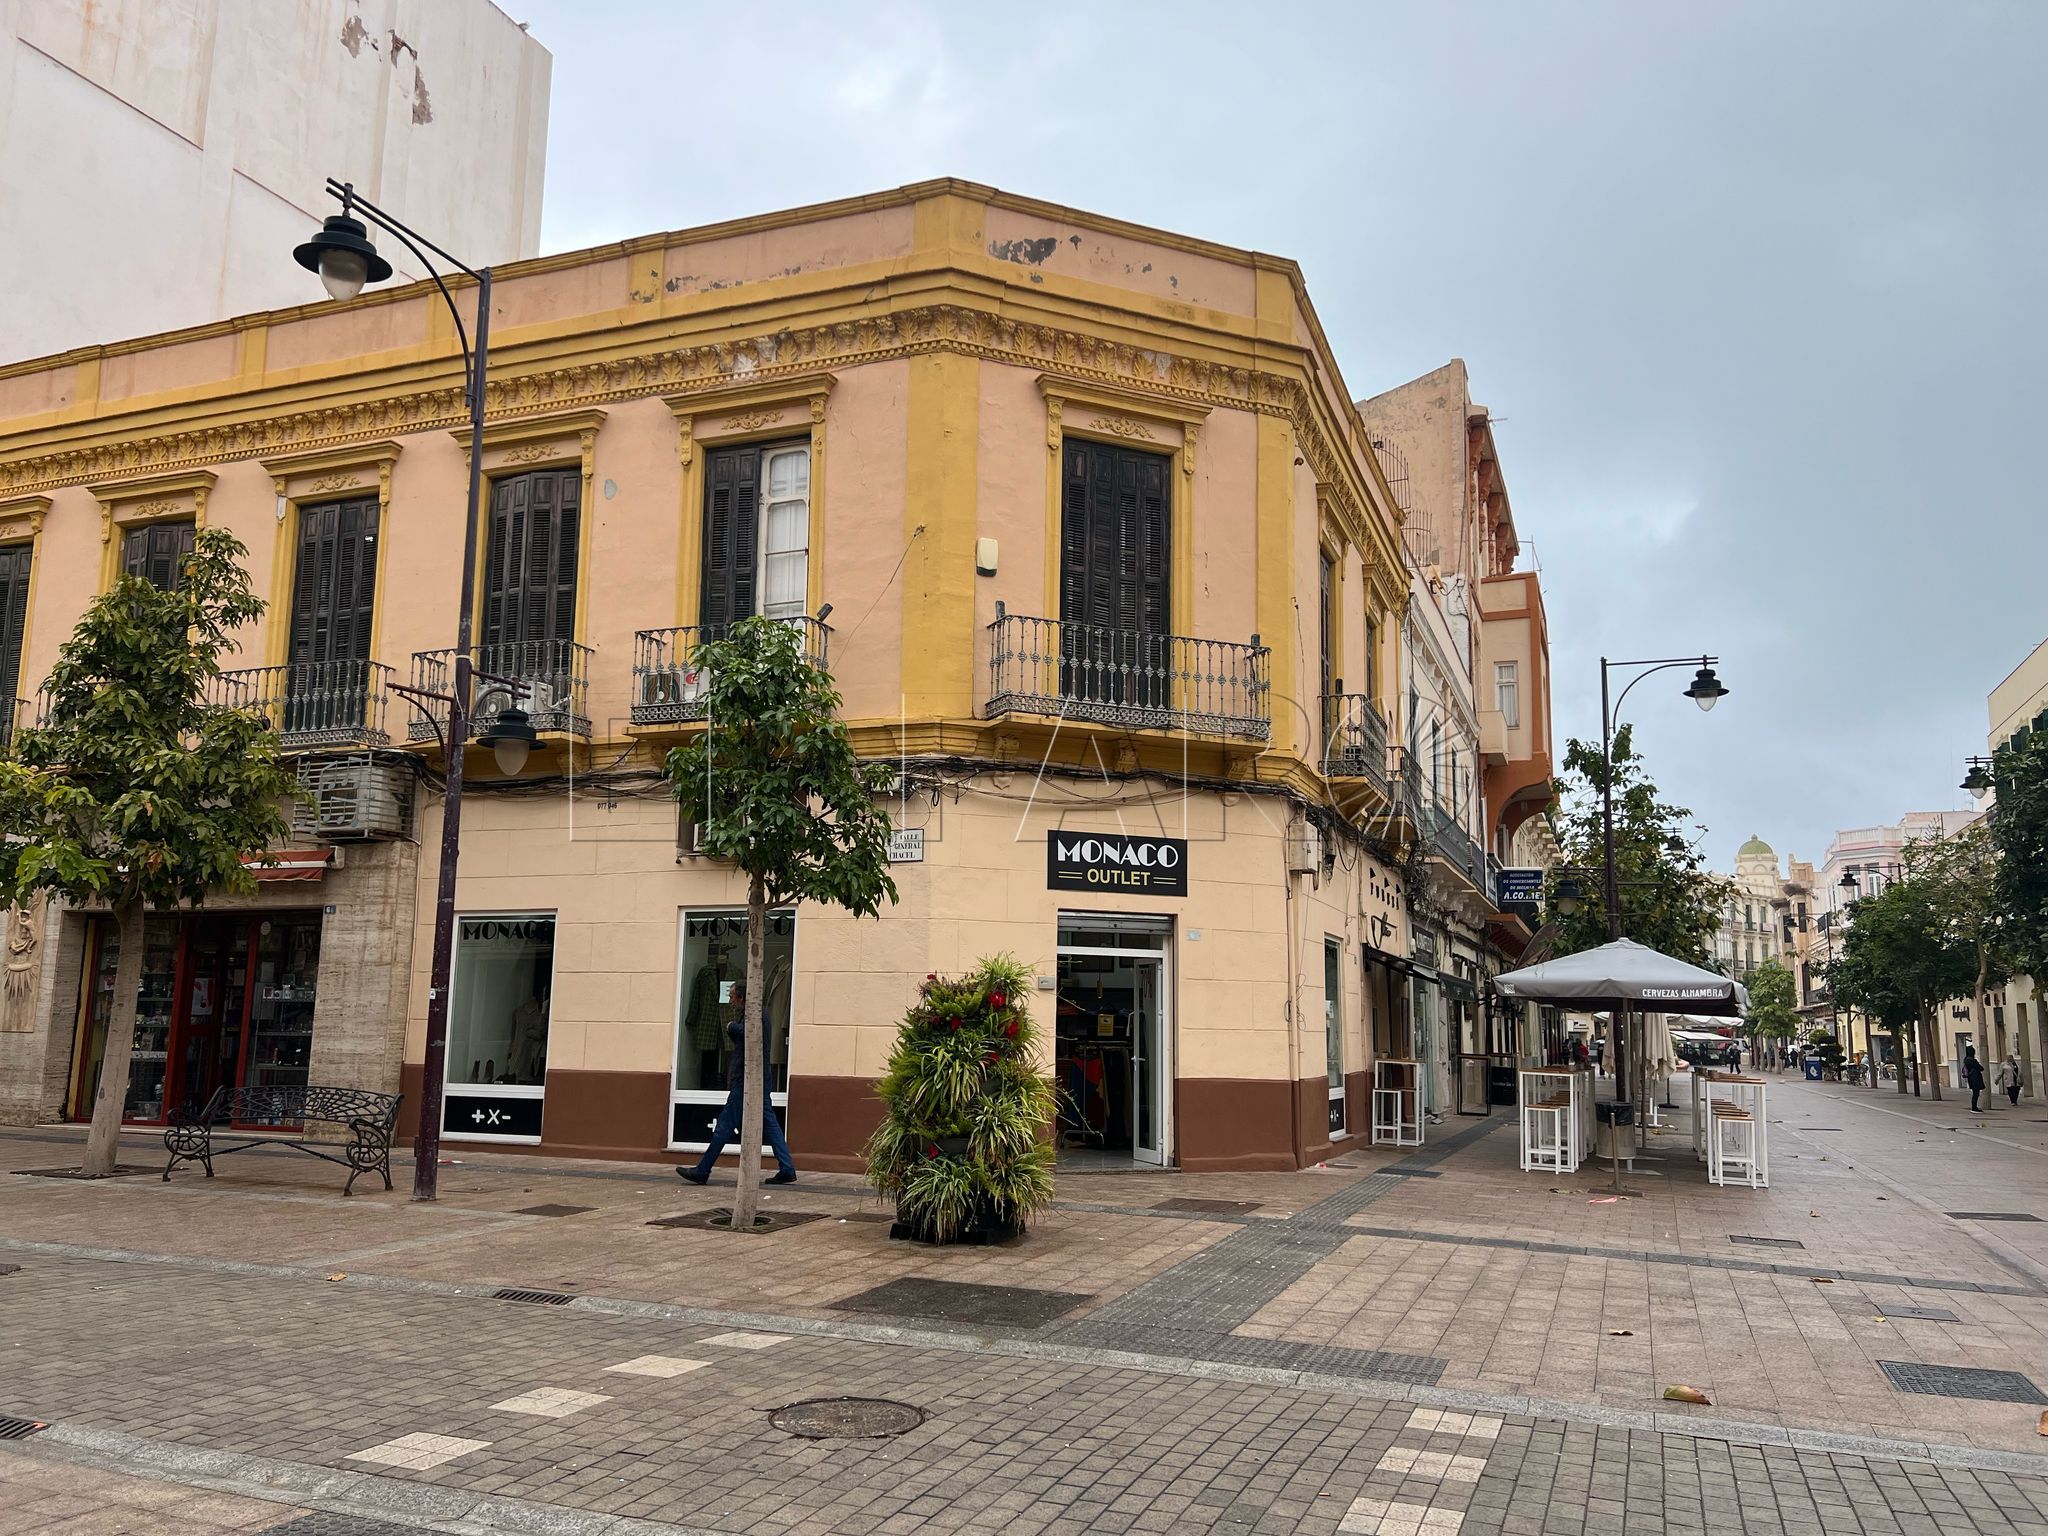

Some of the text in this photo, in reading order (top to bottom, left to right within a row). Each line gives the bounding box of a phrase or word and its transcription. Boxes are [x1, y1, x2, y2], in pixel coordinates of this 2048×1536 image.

[1057, 839, 1178, 868] MONACO
[1087, 868, 1150, 886] OUTLET
[689, 916, 792, 937] MONCO
[1642, 988, 1724, 998] CERVEZAS ALHAMBRA
